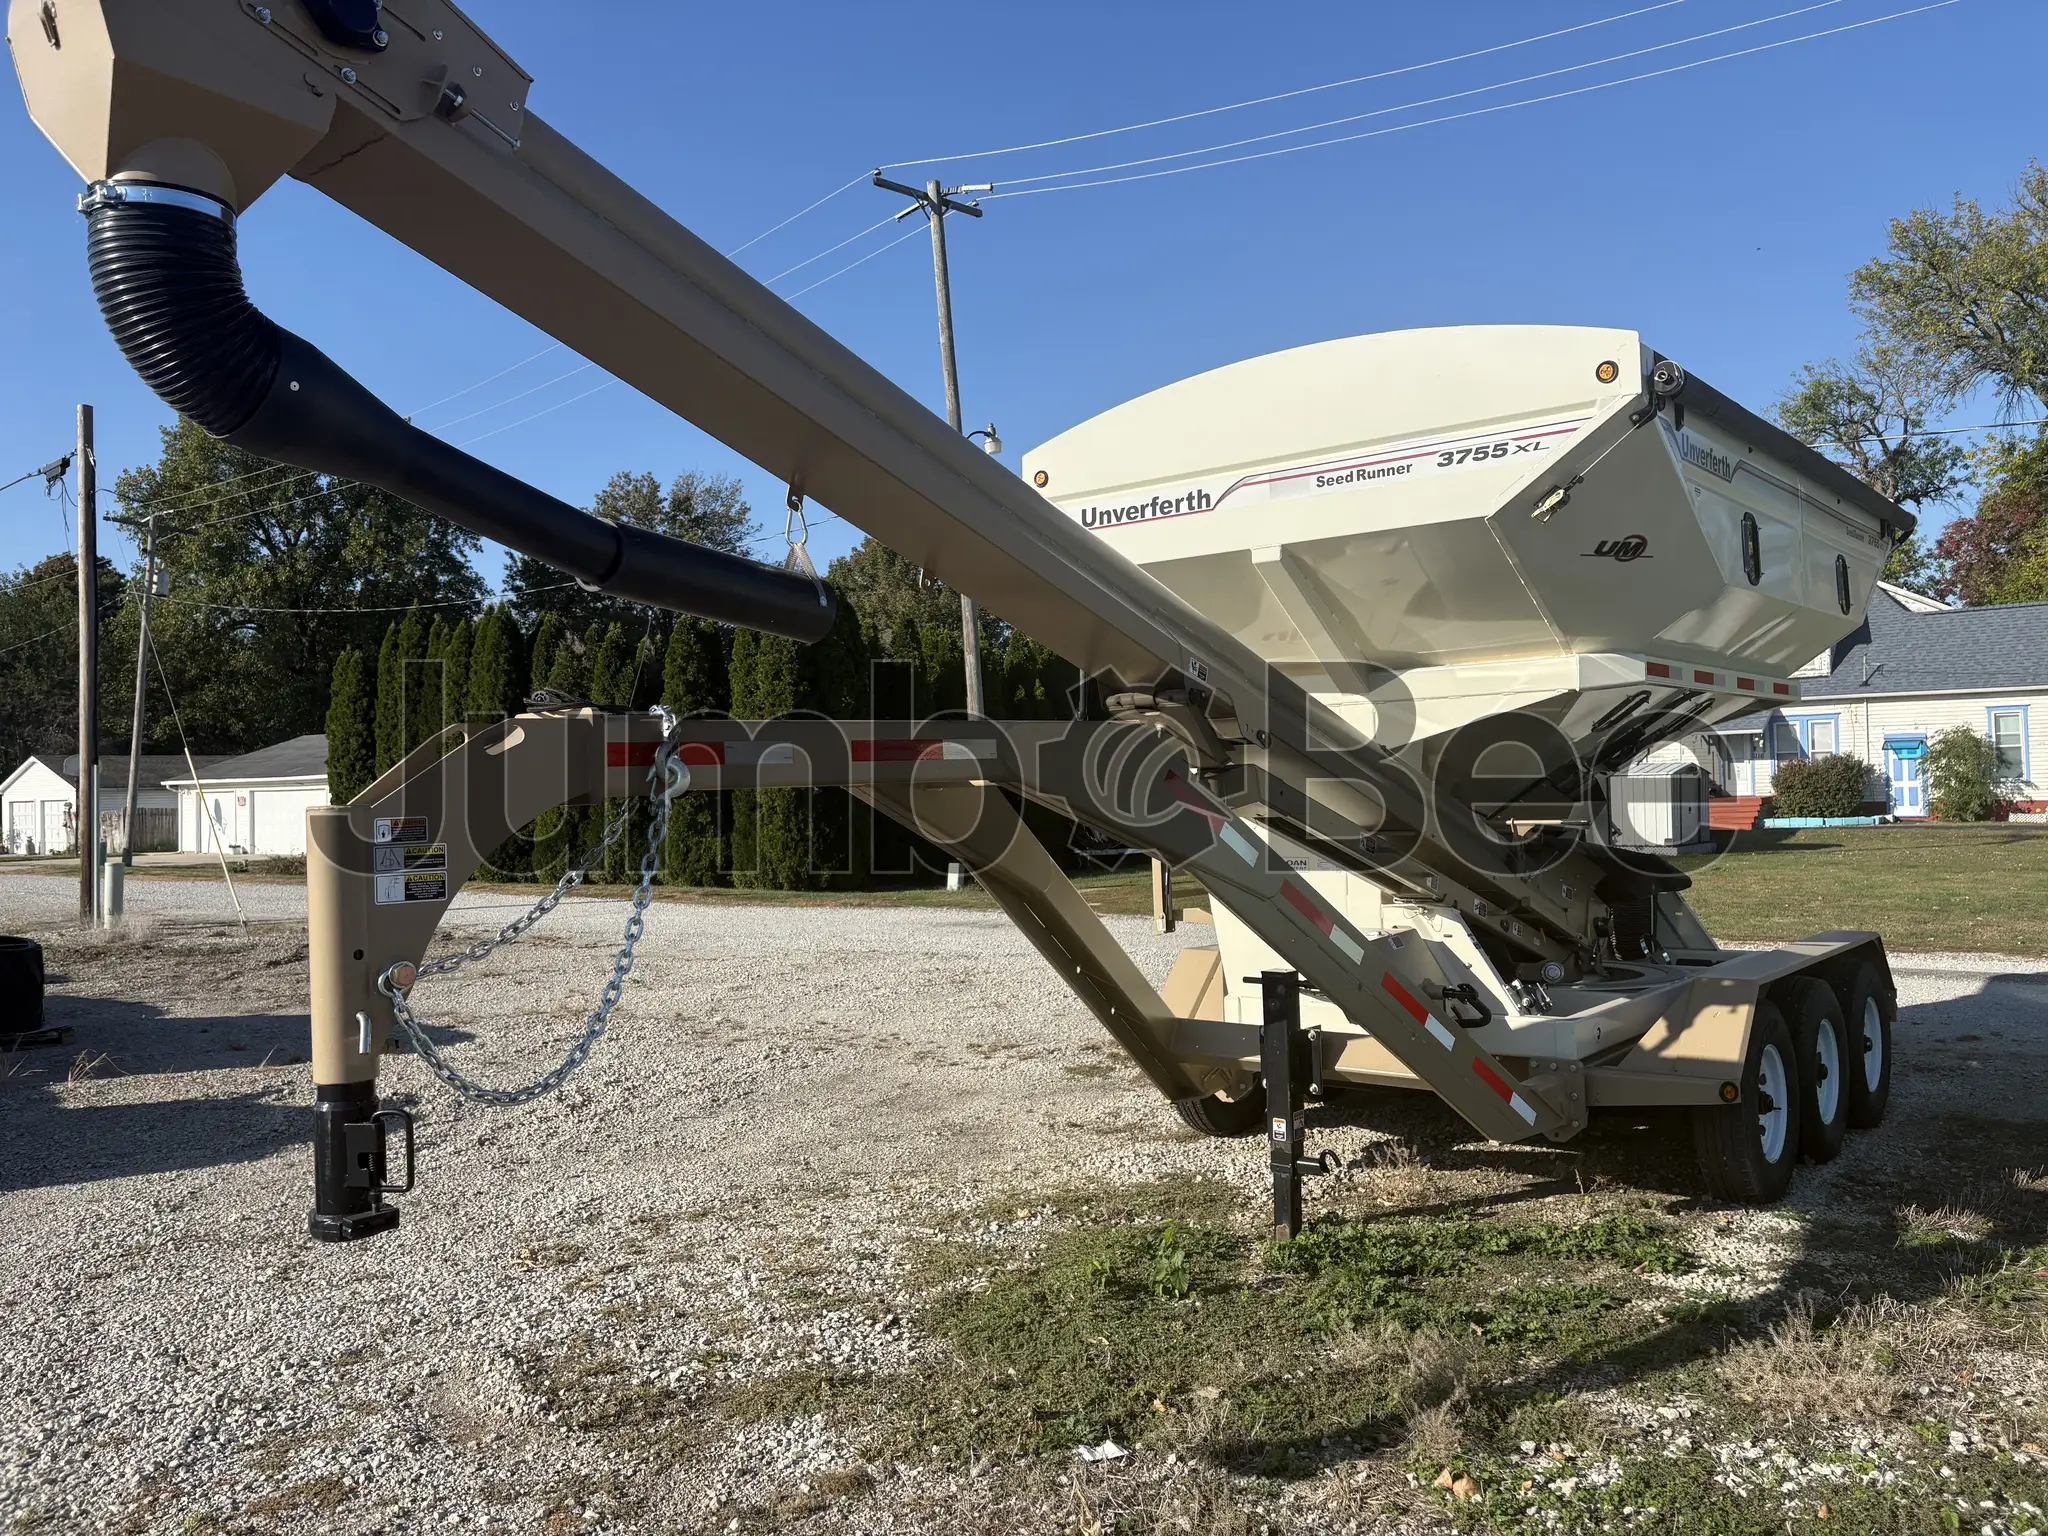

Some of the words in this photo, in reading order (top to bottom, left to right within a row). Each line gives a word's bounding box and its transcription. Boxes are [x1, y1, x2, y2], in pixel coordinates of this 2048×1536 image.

[1316, 471, 1354, 488] Seed
[1356, 462, 1413, 482] Runner
[1436, 442, 1510, 468] 3755
[1510, 441, 1550, 456] XL
[1682, 433, 1731, 479] Unverferth
[1081, 488, 1212, 528] Unverferth
